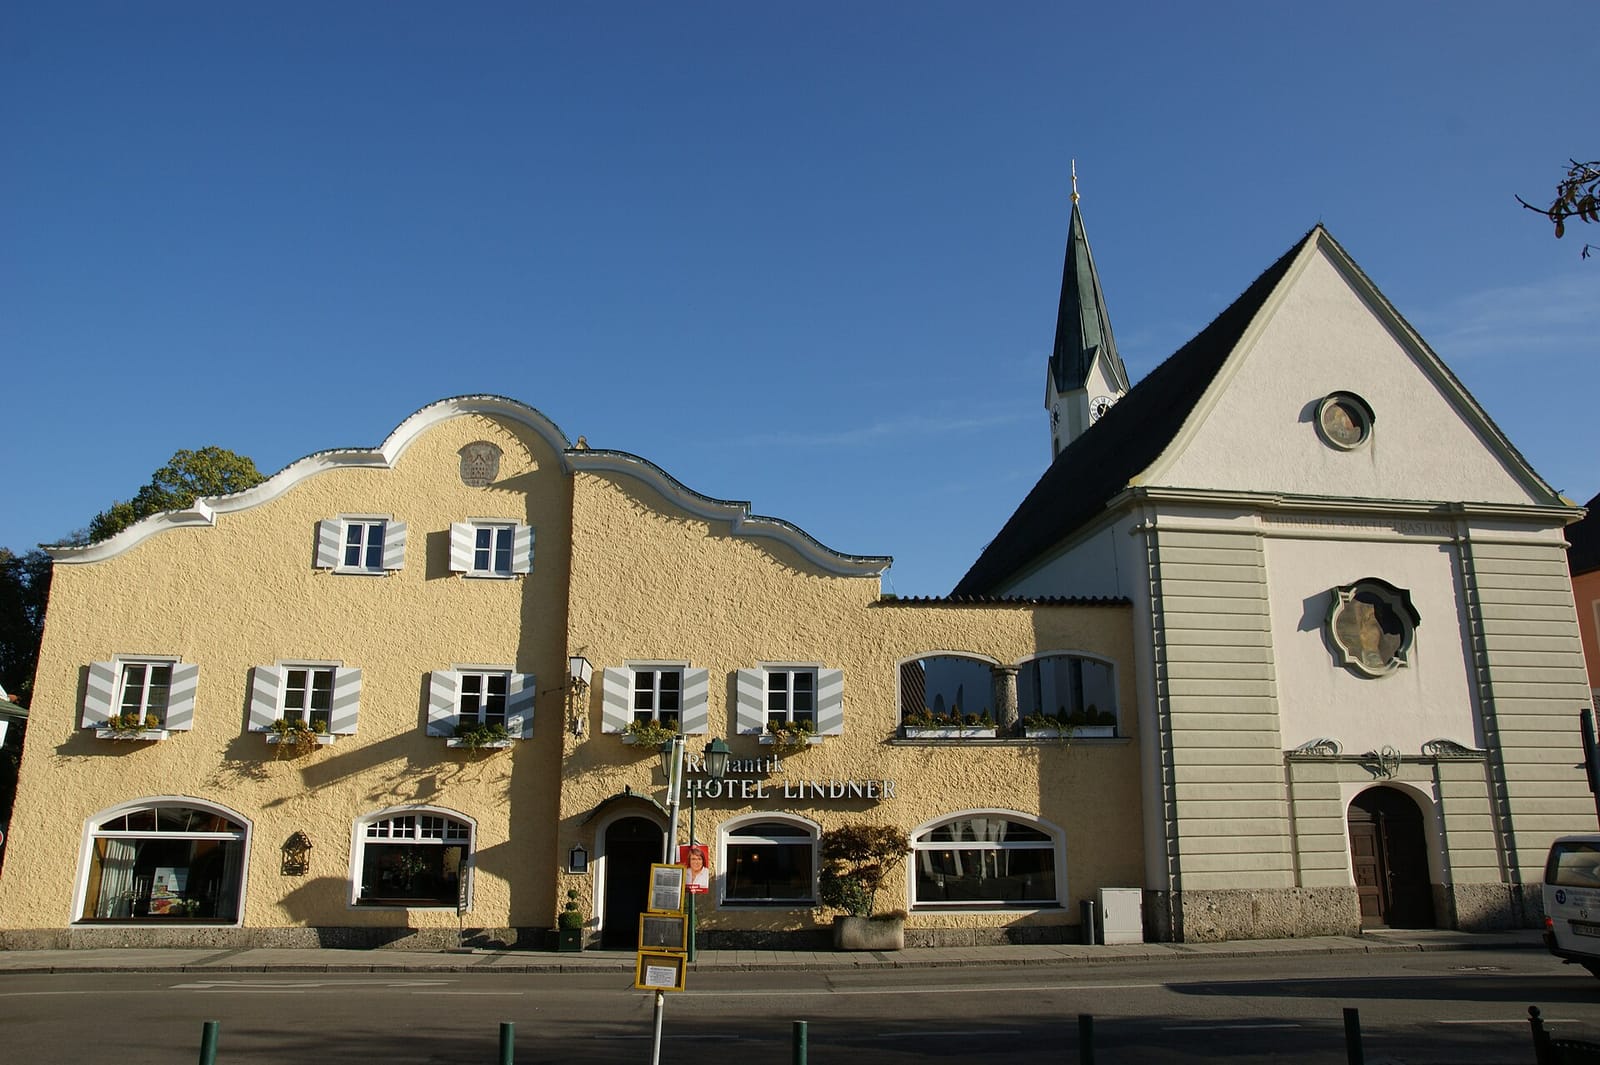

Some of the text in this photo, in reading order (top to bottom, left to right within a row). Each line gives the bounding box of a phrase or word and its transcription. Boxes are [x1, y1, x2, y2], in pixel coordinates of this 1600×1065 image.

[687, 753, 784, 773] Rantik
[687, 779, 897, 799] HOTEL LINDNER
